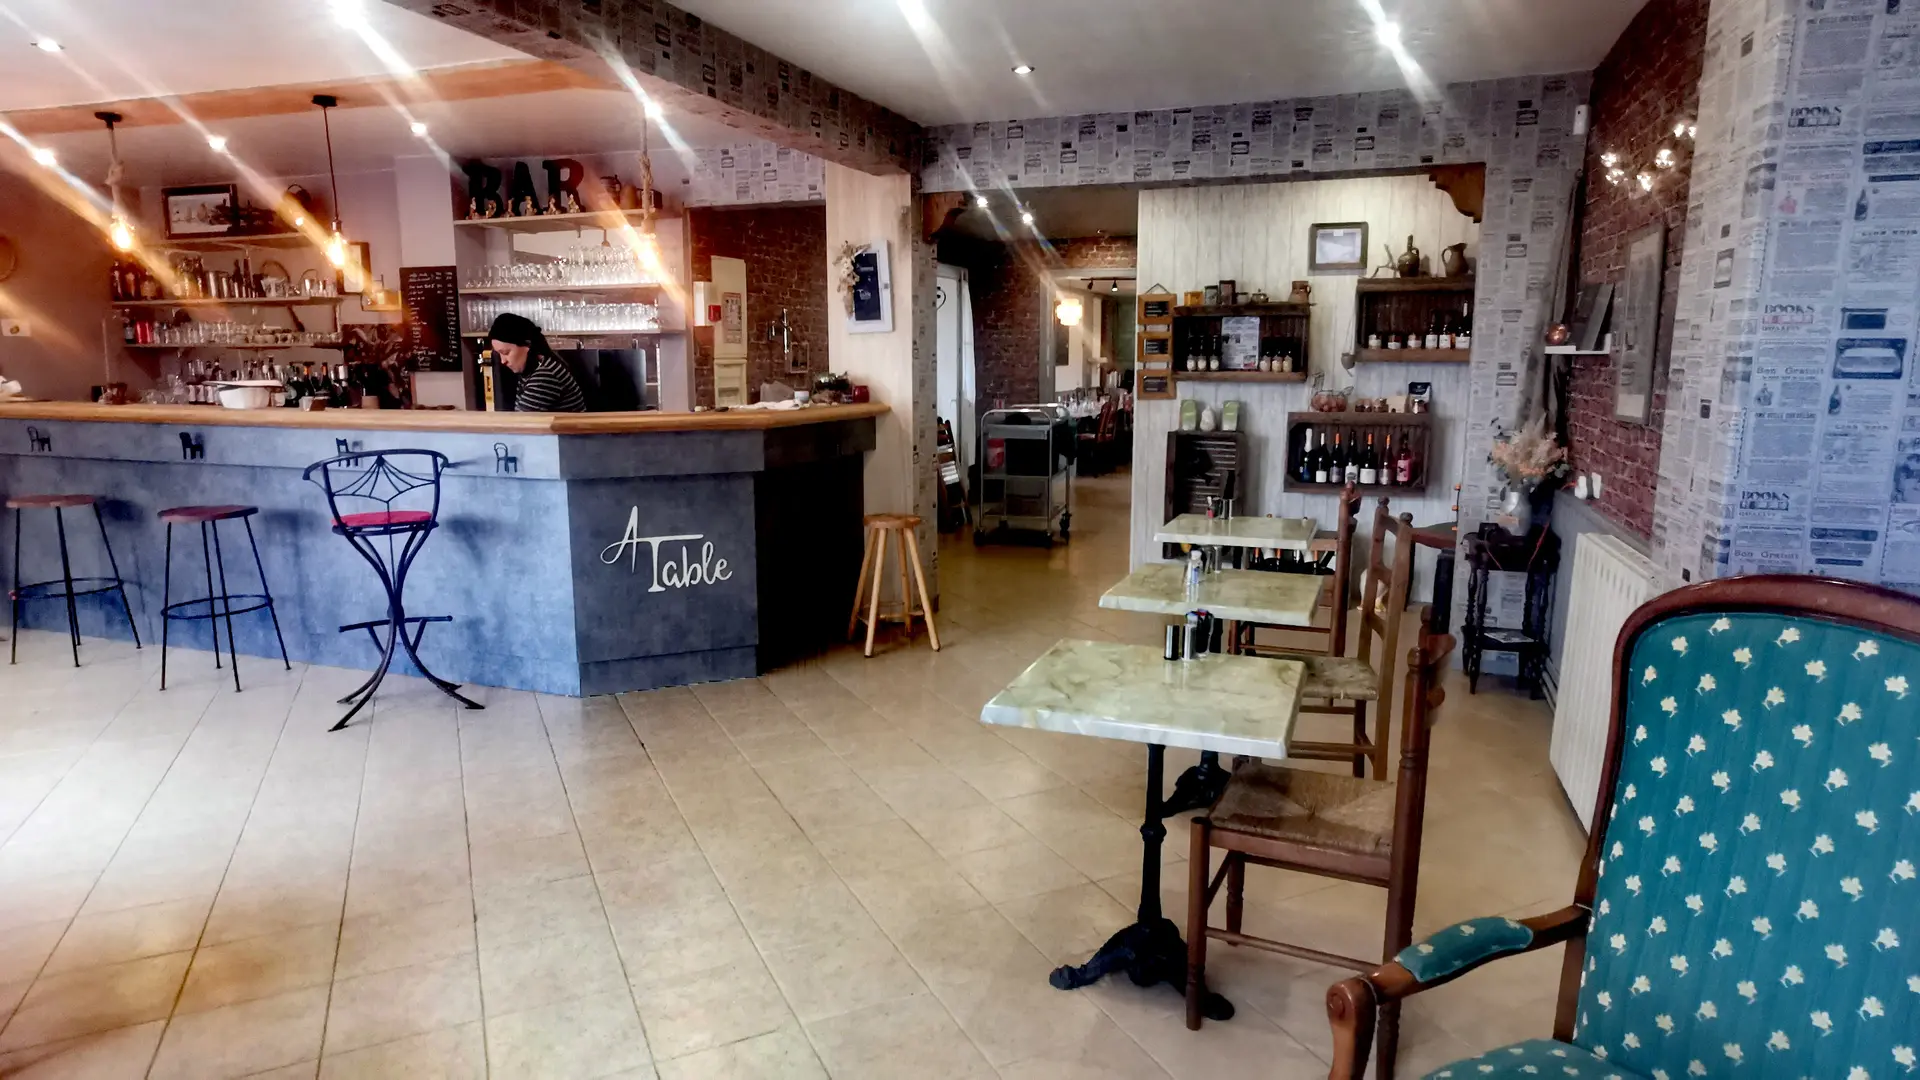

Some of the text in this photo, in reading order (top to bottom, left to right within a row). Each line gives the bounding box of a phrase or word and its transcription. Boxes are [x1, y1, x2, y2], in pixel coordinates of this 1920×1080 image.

[462, 158, 586, 220] BAR
[1764, 304, 1815, 314] BOOKS
[1742, 491, 1790, 500] BOOKS
[600, 505, 733, 593] A Table
